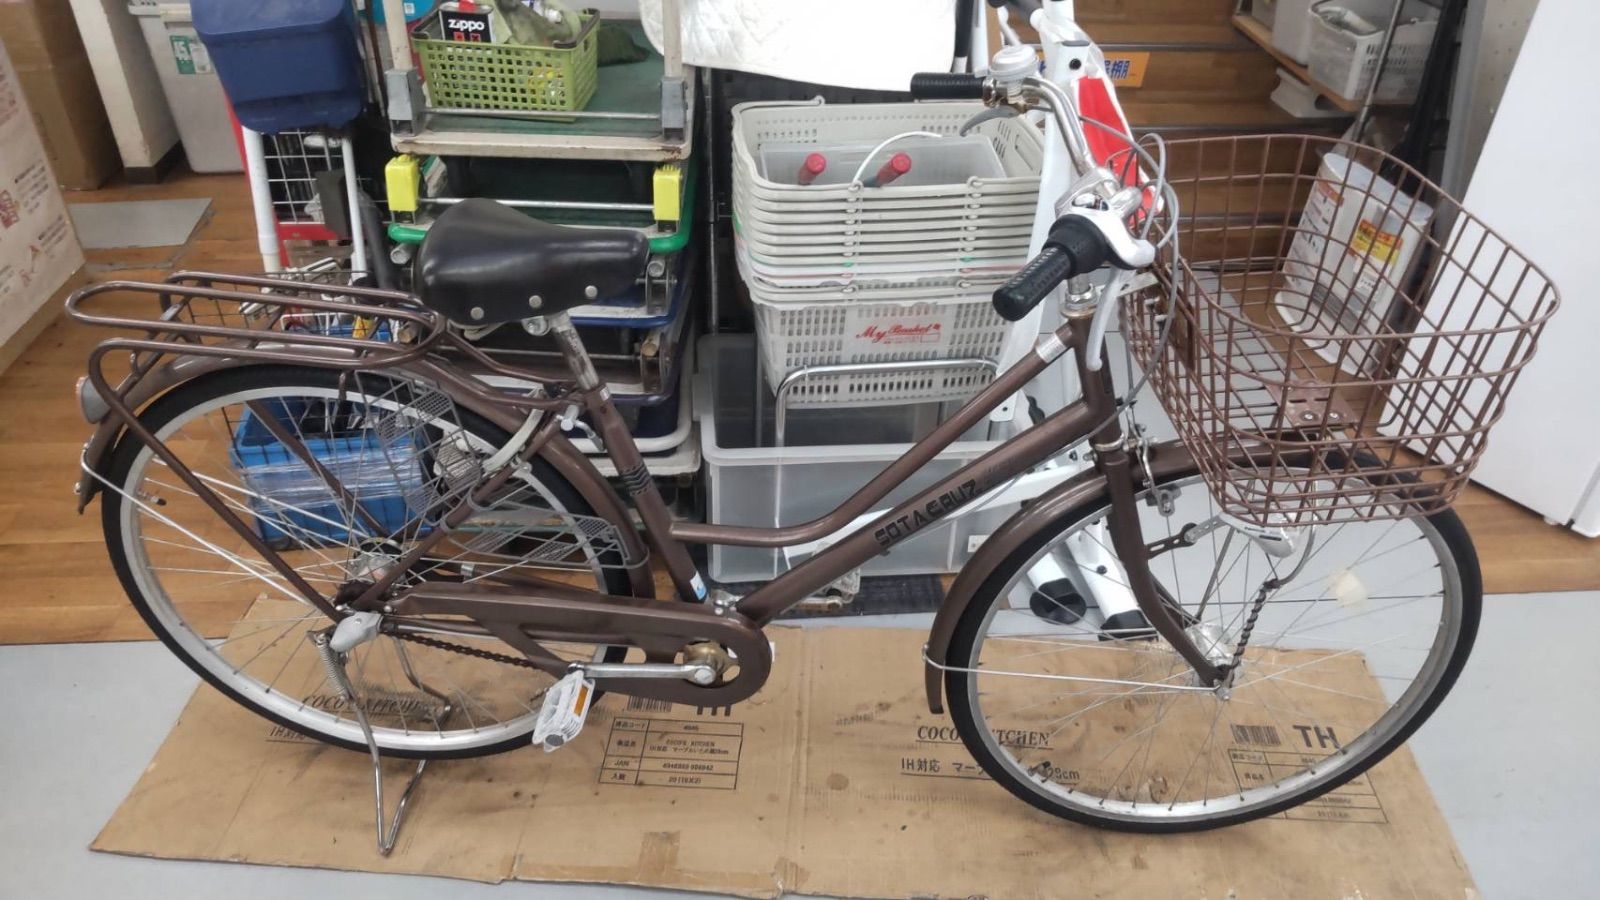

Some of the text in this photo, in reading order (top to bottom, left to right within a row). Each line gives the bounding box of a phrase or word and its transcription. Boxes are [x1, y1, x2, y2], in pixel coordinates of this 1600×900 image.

[855, 324, 887, 344] My
[992, 729, 1050, 746] TCHEN
[1292, 724, 1342, 749] TH
[901, 757, 941, 773] IH対応
